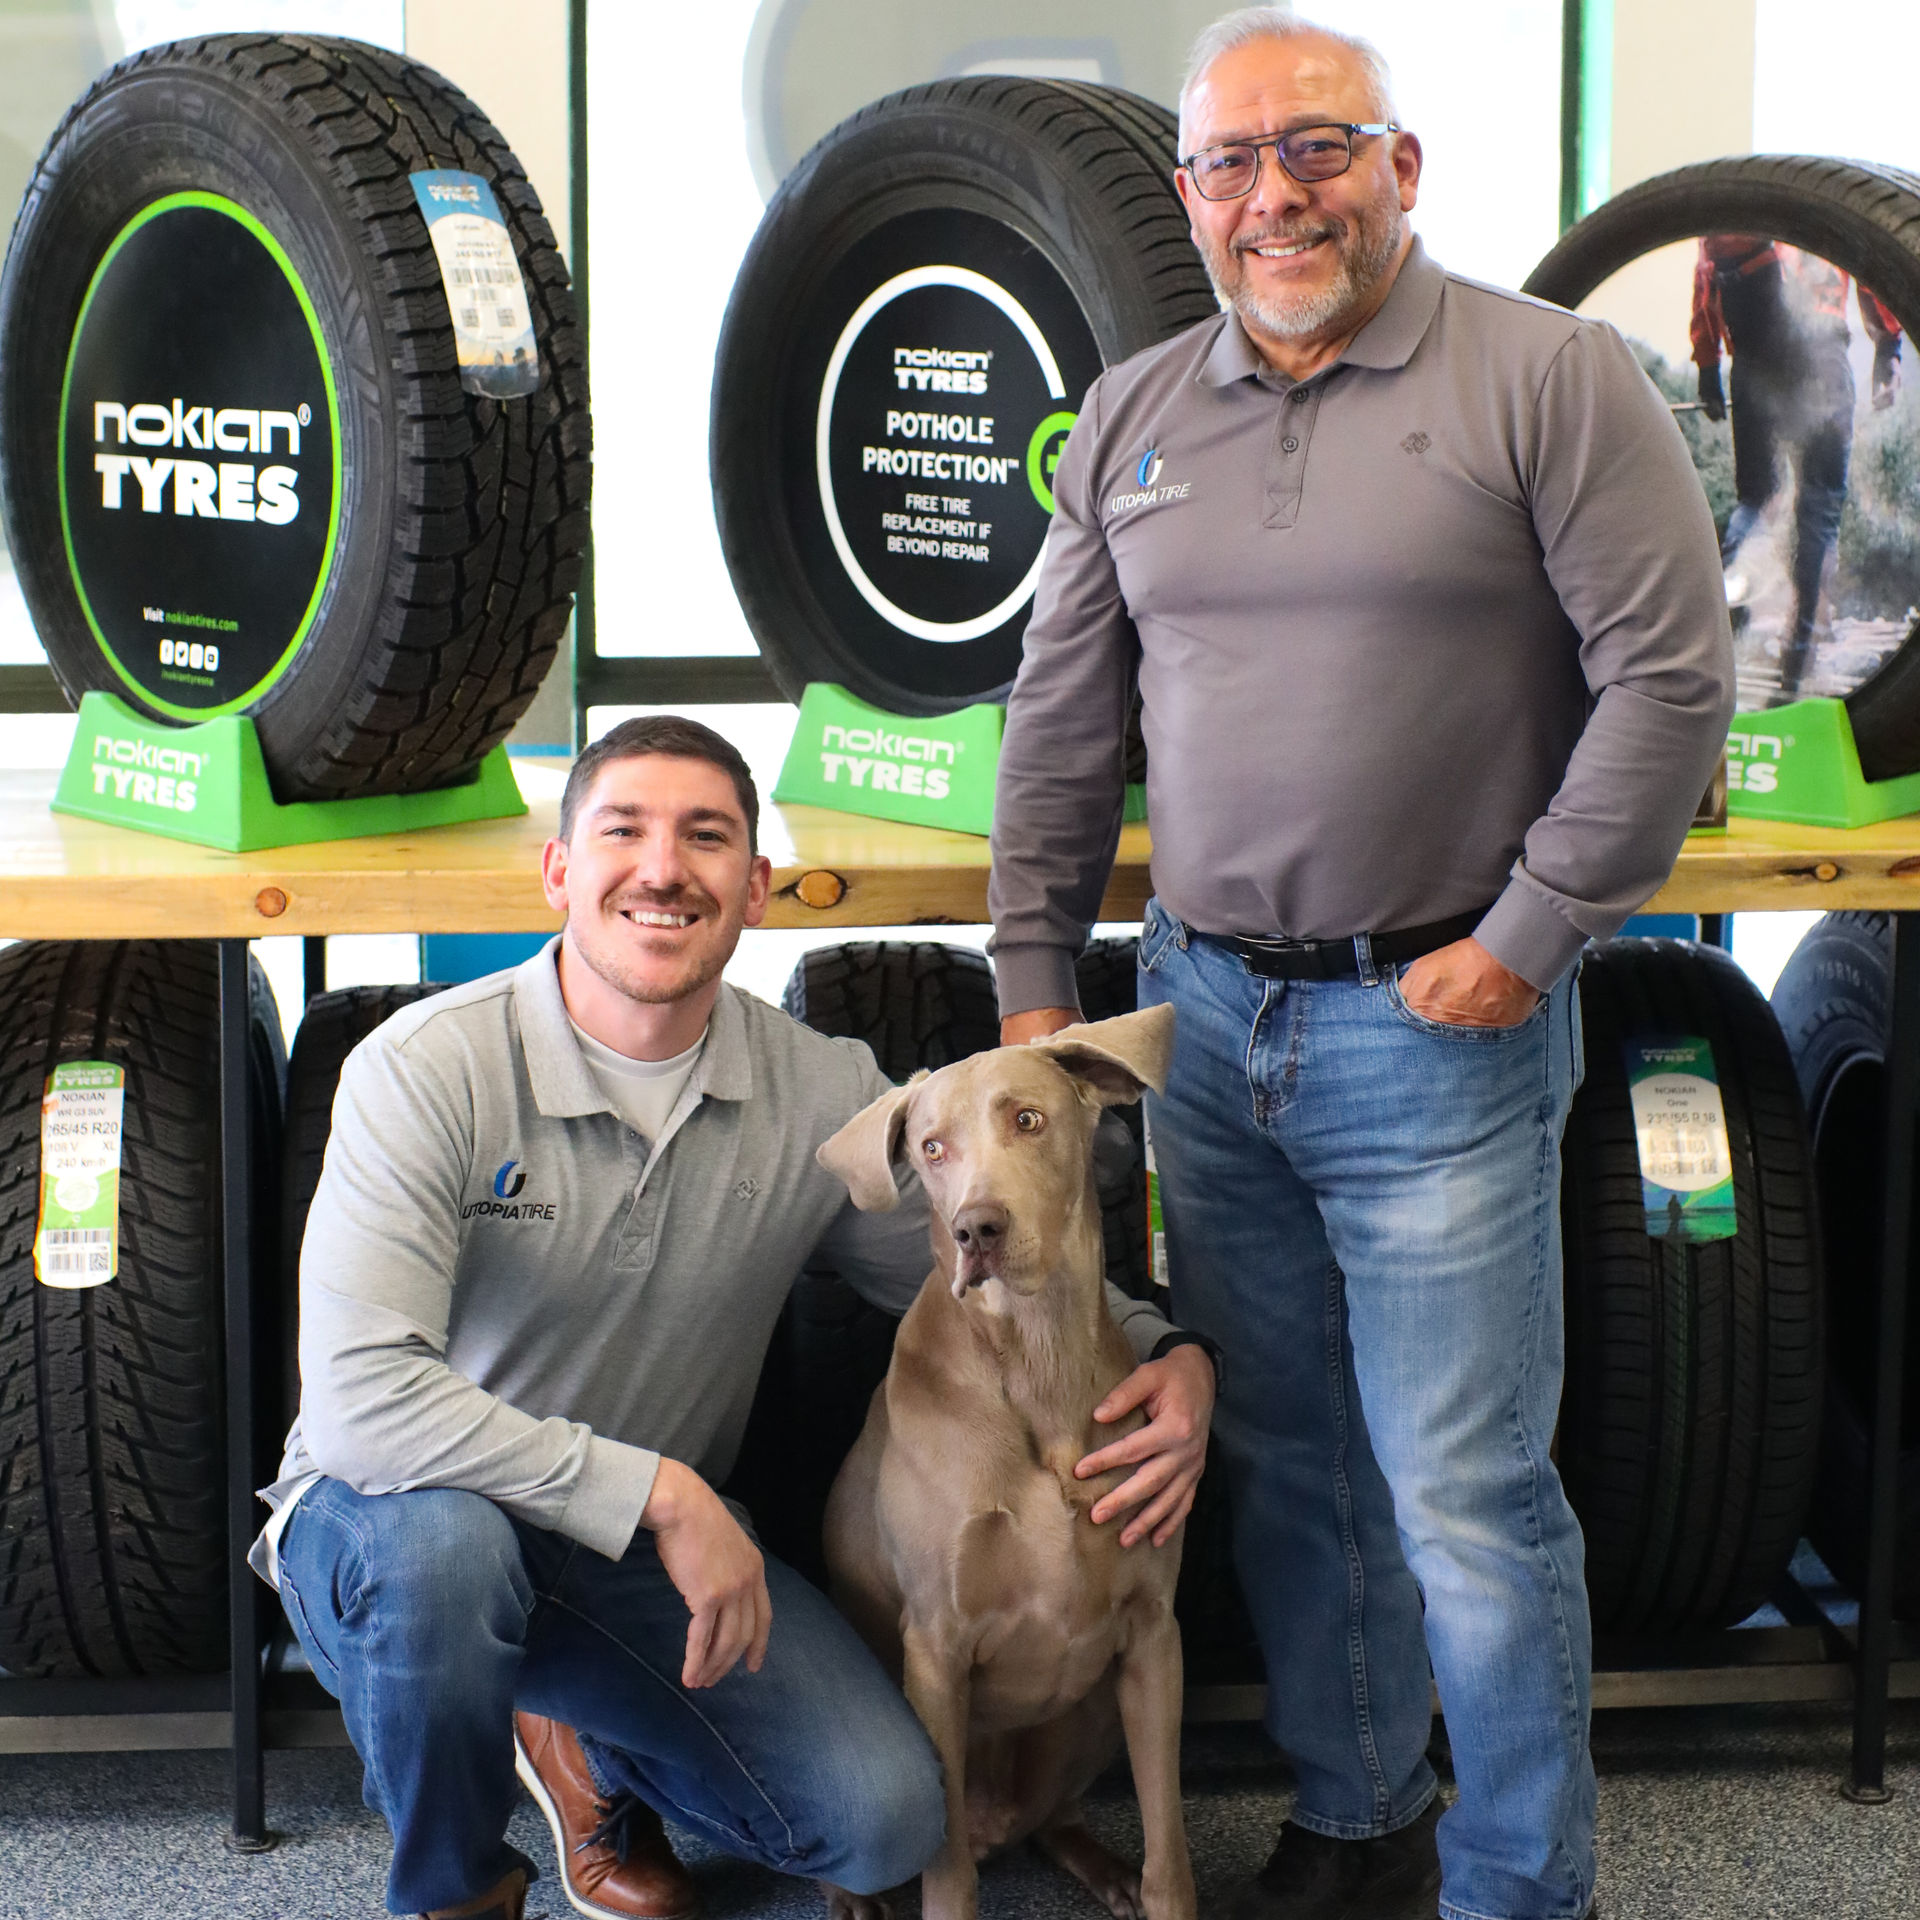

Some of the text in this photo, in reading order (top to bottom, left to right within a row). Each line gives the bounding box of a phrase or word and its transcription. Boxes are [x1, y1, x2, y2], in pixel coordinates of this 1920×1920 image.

[894, 367, 988, 395] TYRES
[886, 410, 994, 444] POTHOLE
[94, 453, 300, 526] TYRES
[1111, 483, 1192, 513] UTOPIA TIRE
[905, 493, 971, 516] FREE TIRE
[881, 512, 992, 540] REPLACEMENT IF
[886, 534, 990, 563] BEYOND REPAIR
[143, 606, 239, 632] Visit nokiantires.com
[92, 762, 198, 812] TYRES
[820, 752, 950, 800] TYRES
[54, 1075, 115, 1087] TYRES
[1655, 1086, 1697, 1095] NOKIAN
[61, 1091, 106, 1103] NOKIAN
[1667, 1099, 1689, 1107] One
[57, 1109, 72, 1117] WR
[87, 1108, 106, 1116] SUV
[1692, 1112, 1700, 1122] R
[1703, 1111, 1717, 1123] 18
[92, 1121, 119, 1135] R20
[70, 1142, 78, 1152] V
[102, 1140, 116, 1151] XL
[461, 1201, 557, 1220] UTOPIA TIRE
